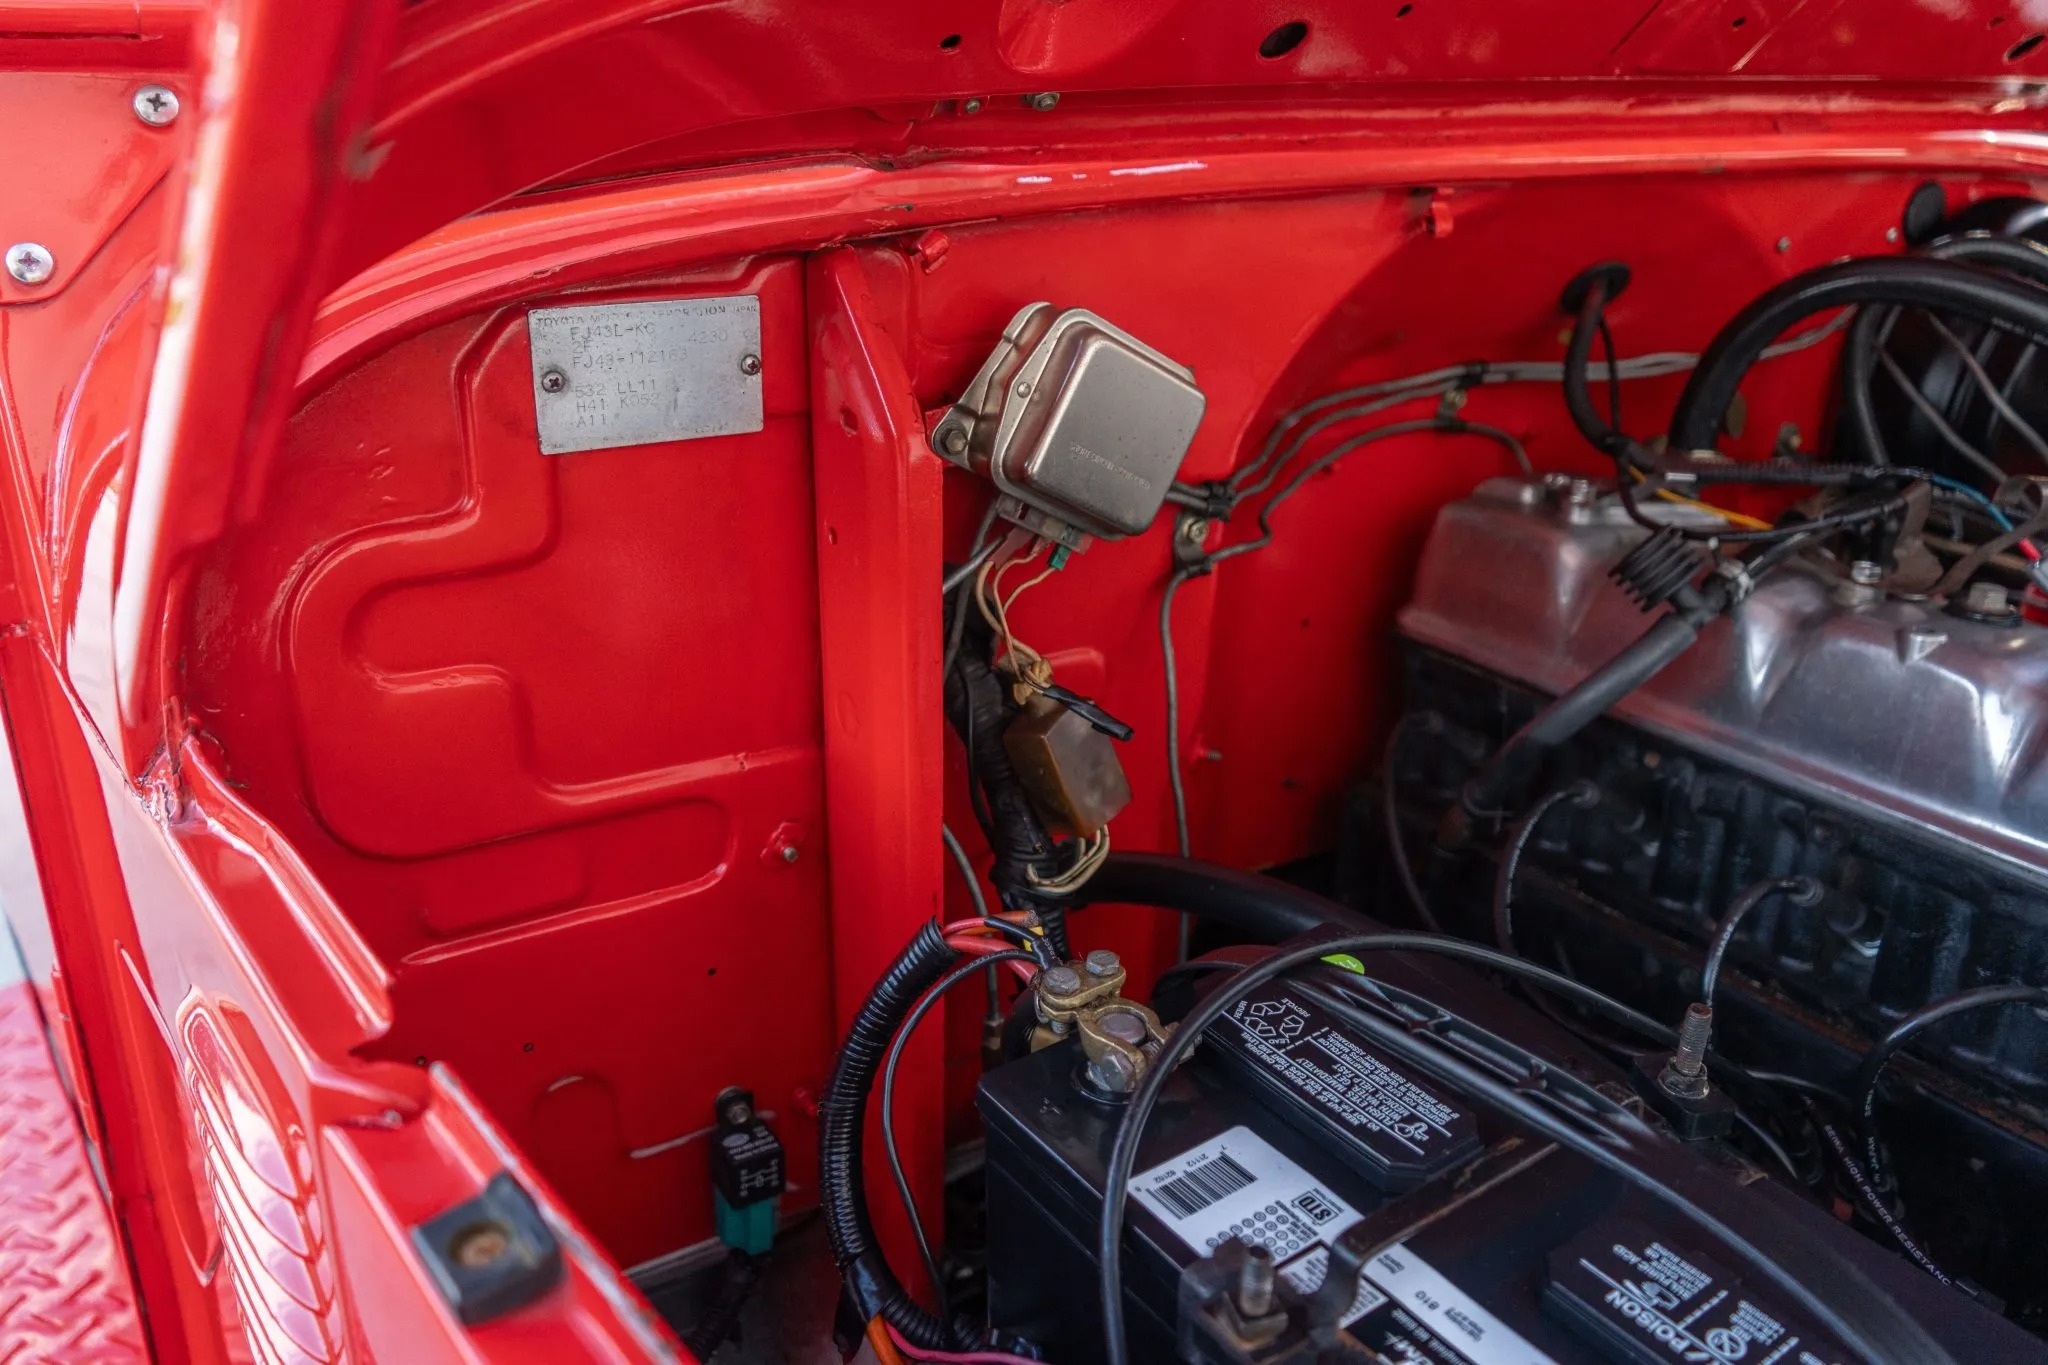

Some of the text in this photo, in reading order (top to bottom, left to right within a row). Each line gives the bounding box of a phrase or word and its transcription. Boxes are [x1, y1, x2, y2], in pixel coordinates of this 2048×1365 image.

[537, 316, 584, 328] TOYOTA
[576, 398, 606, 413] H41
[1241, 1031, 1259, 1045] LEVEL
[1268, 1037, 1290, 1046] LEAD
[1245, 1042, 1275, 1064] CHILDREN
[1257, 1044, 1272, 1054] AND
[1317, 1037, 1342, 1055] FOLLOW
[1270, 1054, 1290, 1068] TIGHT
[1340, 1053, 1370, 1075] STARTING
[1364, 1054, 1390, 1073] SERVICE
[1283, 1070, 1305, 1085] REACH
[1288, 1066, 1307, 1079] CAPS
[1332, 1073, 1351, 1086] GET
[1373, 1068, 1399, 1087] VEHICLE
[1388, 1071, 1406, 1084] SEEK
[1305, 1078, 1323, 1092] VENT
[1368, 1074, 1387, 1086] JUMP
[1296, 1058, 1394, 1126] FLUSH EYES IMMEDIATELY
[1303, 1084, 1317, 1096] THE
[1321, 1090, 1340, 1103] KEEP
[1332, 1063, 1410, 1117] MEDICAL HELP FAST
[1385, 1084, 1404, 1097] SAFE
[1404, 1082, 1438, 1104] AVAILABLE
[1316, 1094, 1328, 1102] OF
[1401, 1095, 1417, 1107] FOR
[1326, 1101, 1343, 1112] OUT
[1378, 1104, 1402, 1122] WITH
[1406, 1090, 1451, 1122] INSTRUCTIONS
[1435, 1103, 1452, 1114] NOT
[1341, 1112, 1360, 1125] KEEP
[1352, 1112, 1369, 1124] NOT
[1367, 1122, 1380, 1131] DO
[1186, 1153, 1208, 1168] 21112
[1298, 1196, 1332, 1221] STD
[1862, 1186, 1893, 1224] POWER
[1613, 1244, 1641, 1264] ACID
[1415, 1290, 1440, 1311] 810
